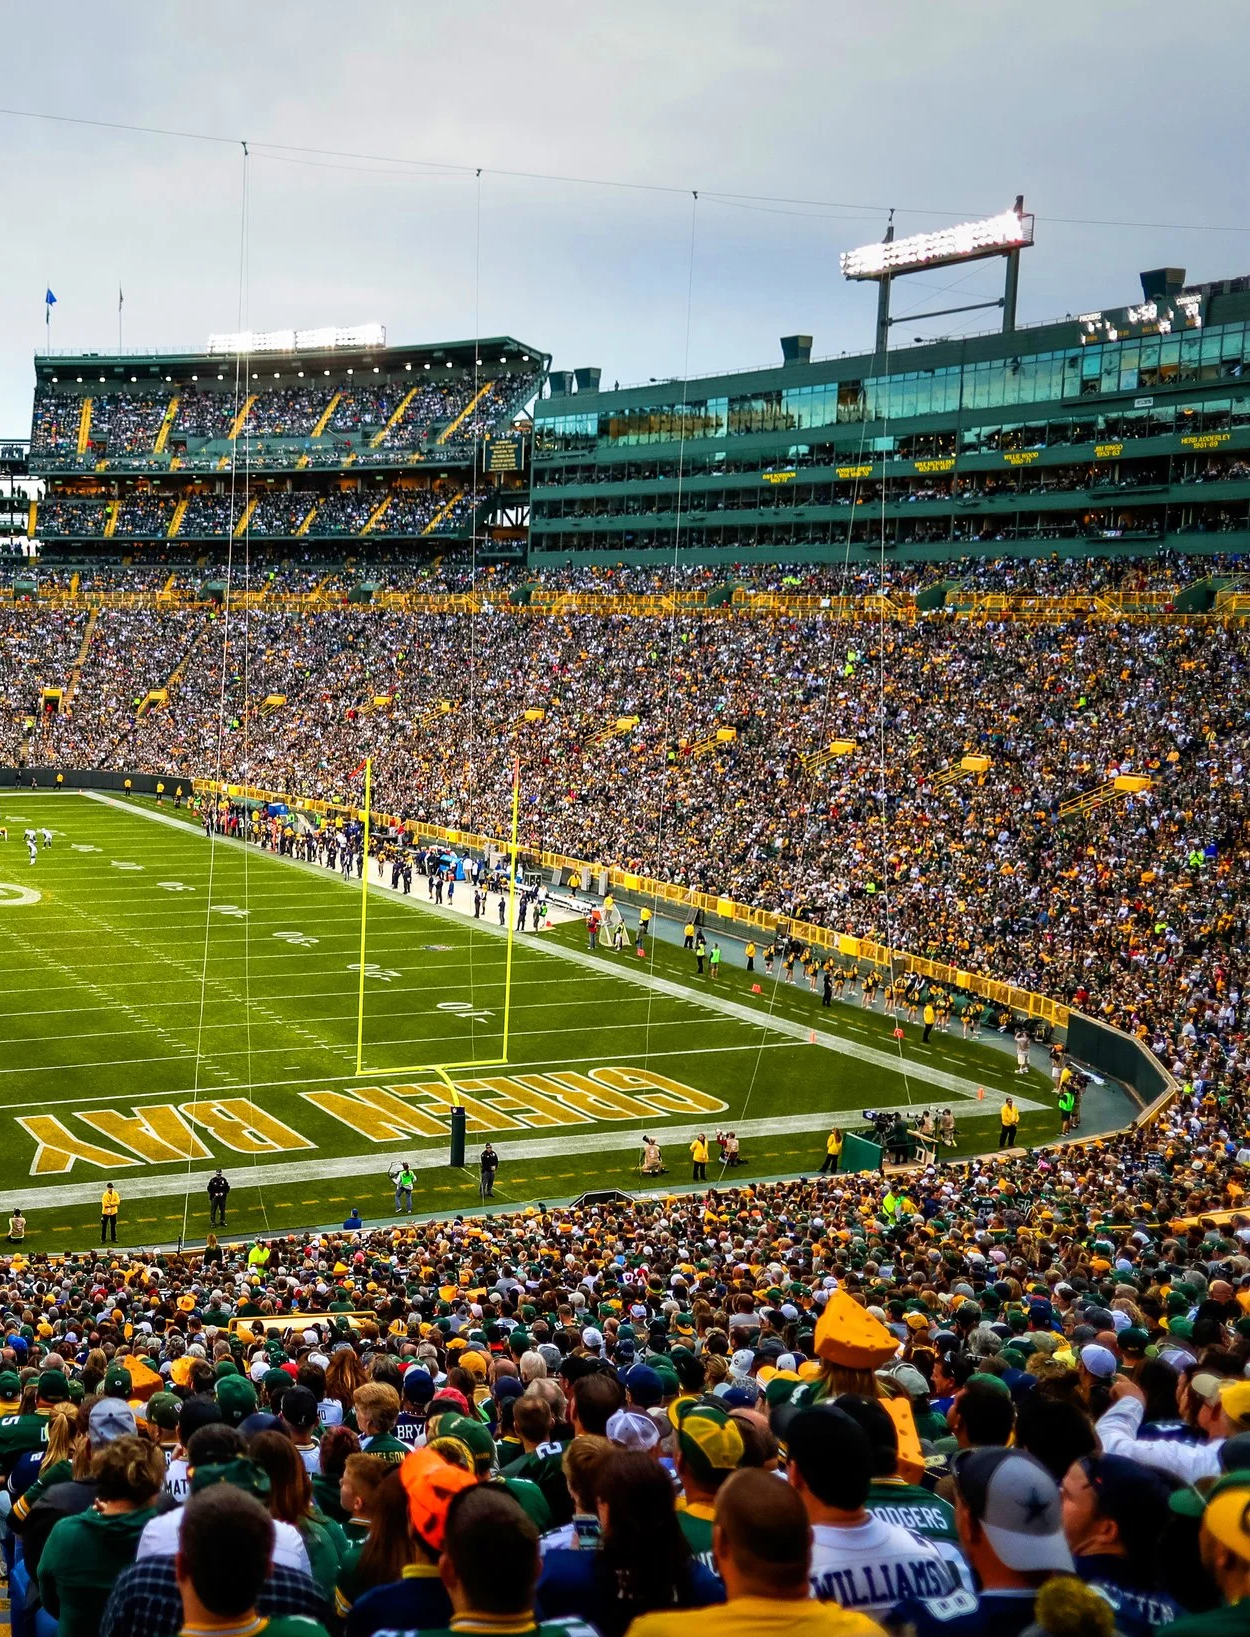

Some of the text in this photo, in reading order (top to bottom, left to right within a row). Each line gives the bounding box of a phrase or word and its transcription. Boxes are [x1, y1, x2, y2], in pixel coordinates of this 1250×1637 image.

[346, 963, 402, 980] 20
[436, 1002, 496, 1019] 10
[15, 1066, 730, 1176] GREEN BAY
[810, 1560, 942, 1610] WILLIAMS
